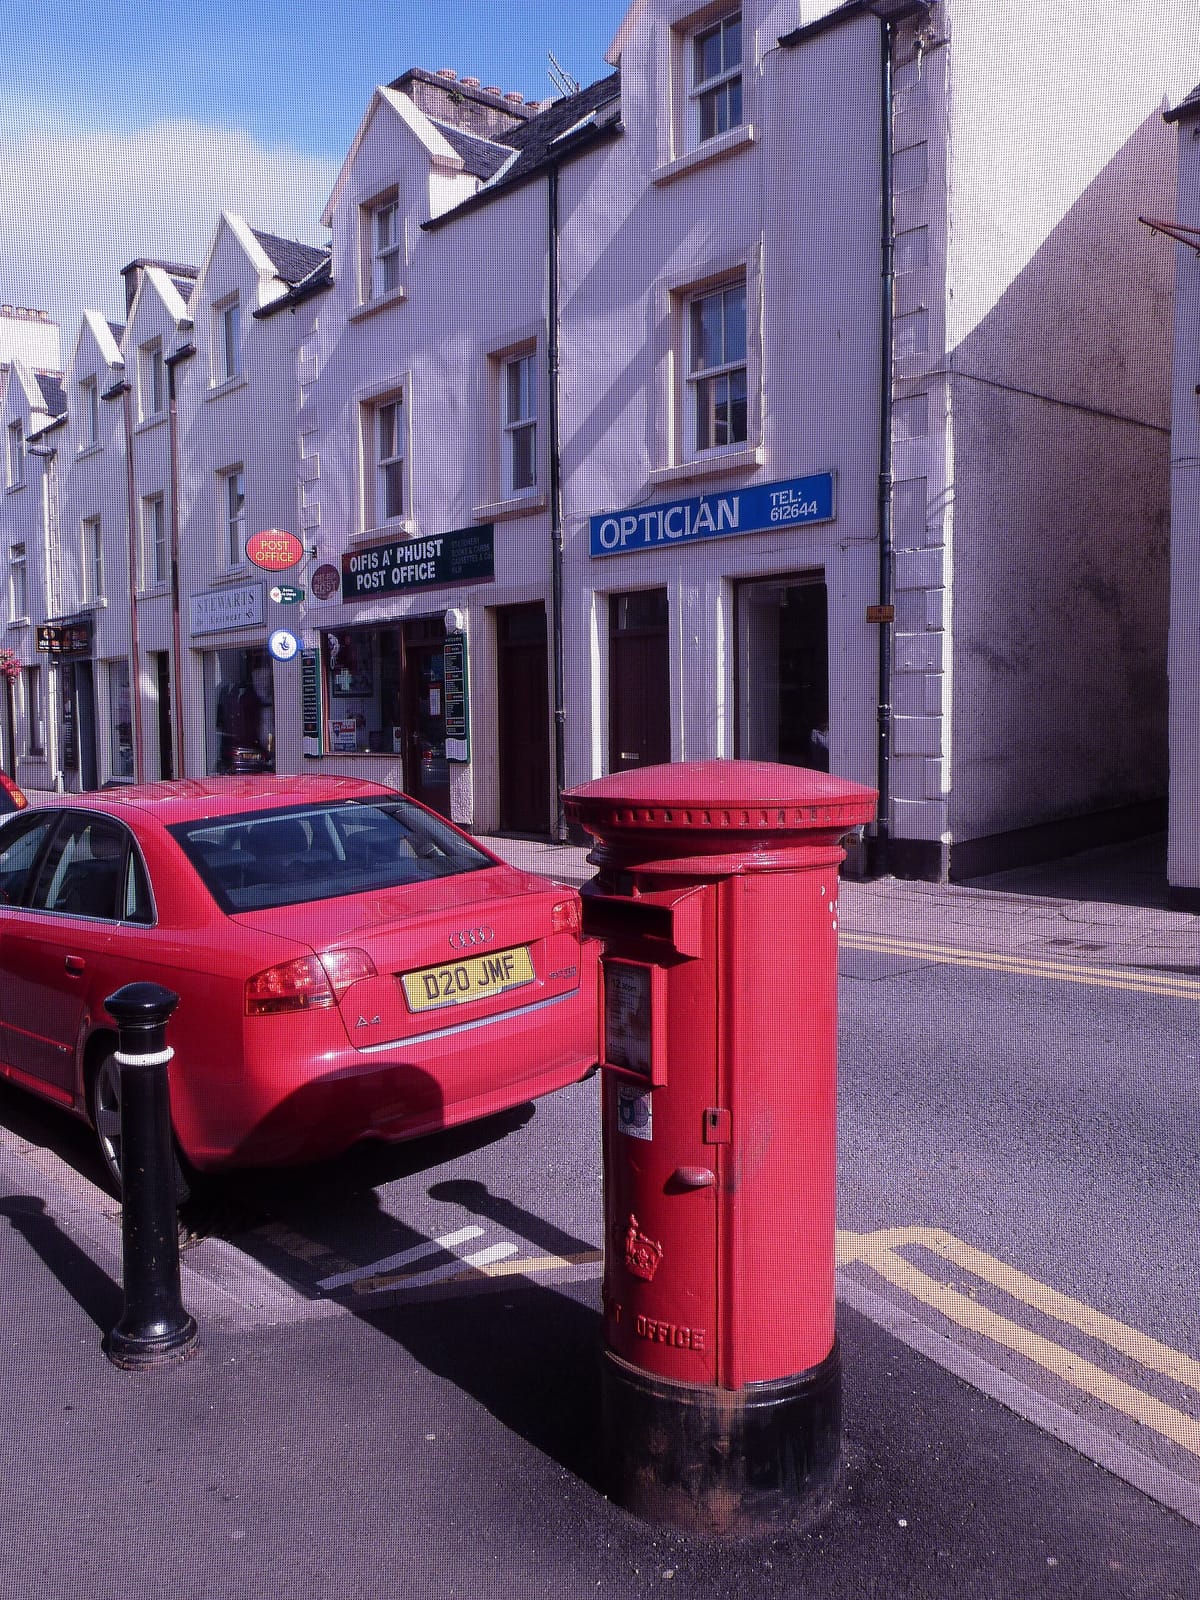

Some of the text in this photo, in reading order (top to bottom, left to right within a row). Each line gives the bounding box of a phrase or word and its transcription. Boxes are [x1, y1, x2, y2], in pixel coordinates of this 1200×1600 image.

[769, 489, 802, 506] TEL:
[770, 500, 818, 522] 612644
[600, 498, 740, 549] OPTICIAN
[255, 551, 293, 562] OFFICE
[261, 540, 290, 550] POST
[350, 539, 444, 573] OIFIS A' PHUIST
[356, 570, 386, 590] POST
[391, 561, 436, 585] OFFICE
[197, 589, 254, 614] STEWARTS
[422, 966, 470, 1000] D20
[477, 954, 513, 986] JMF
[637, 1314, 706, 1351] OFFICE
